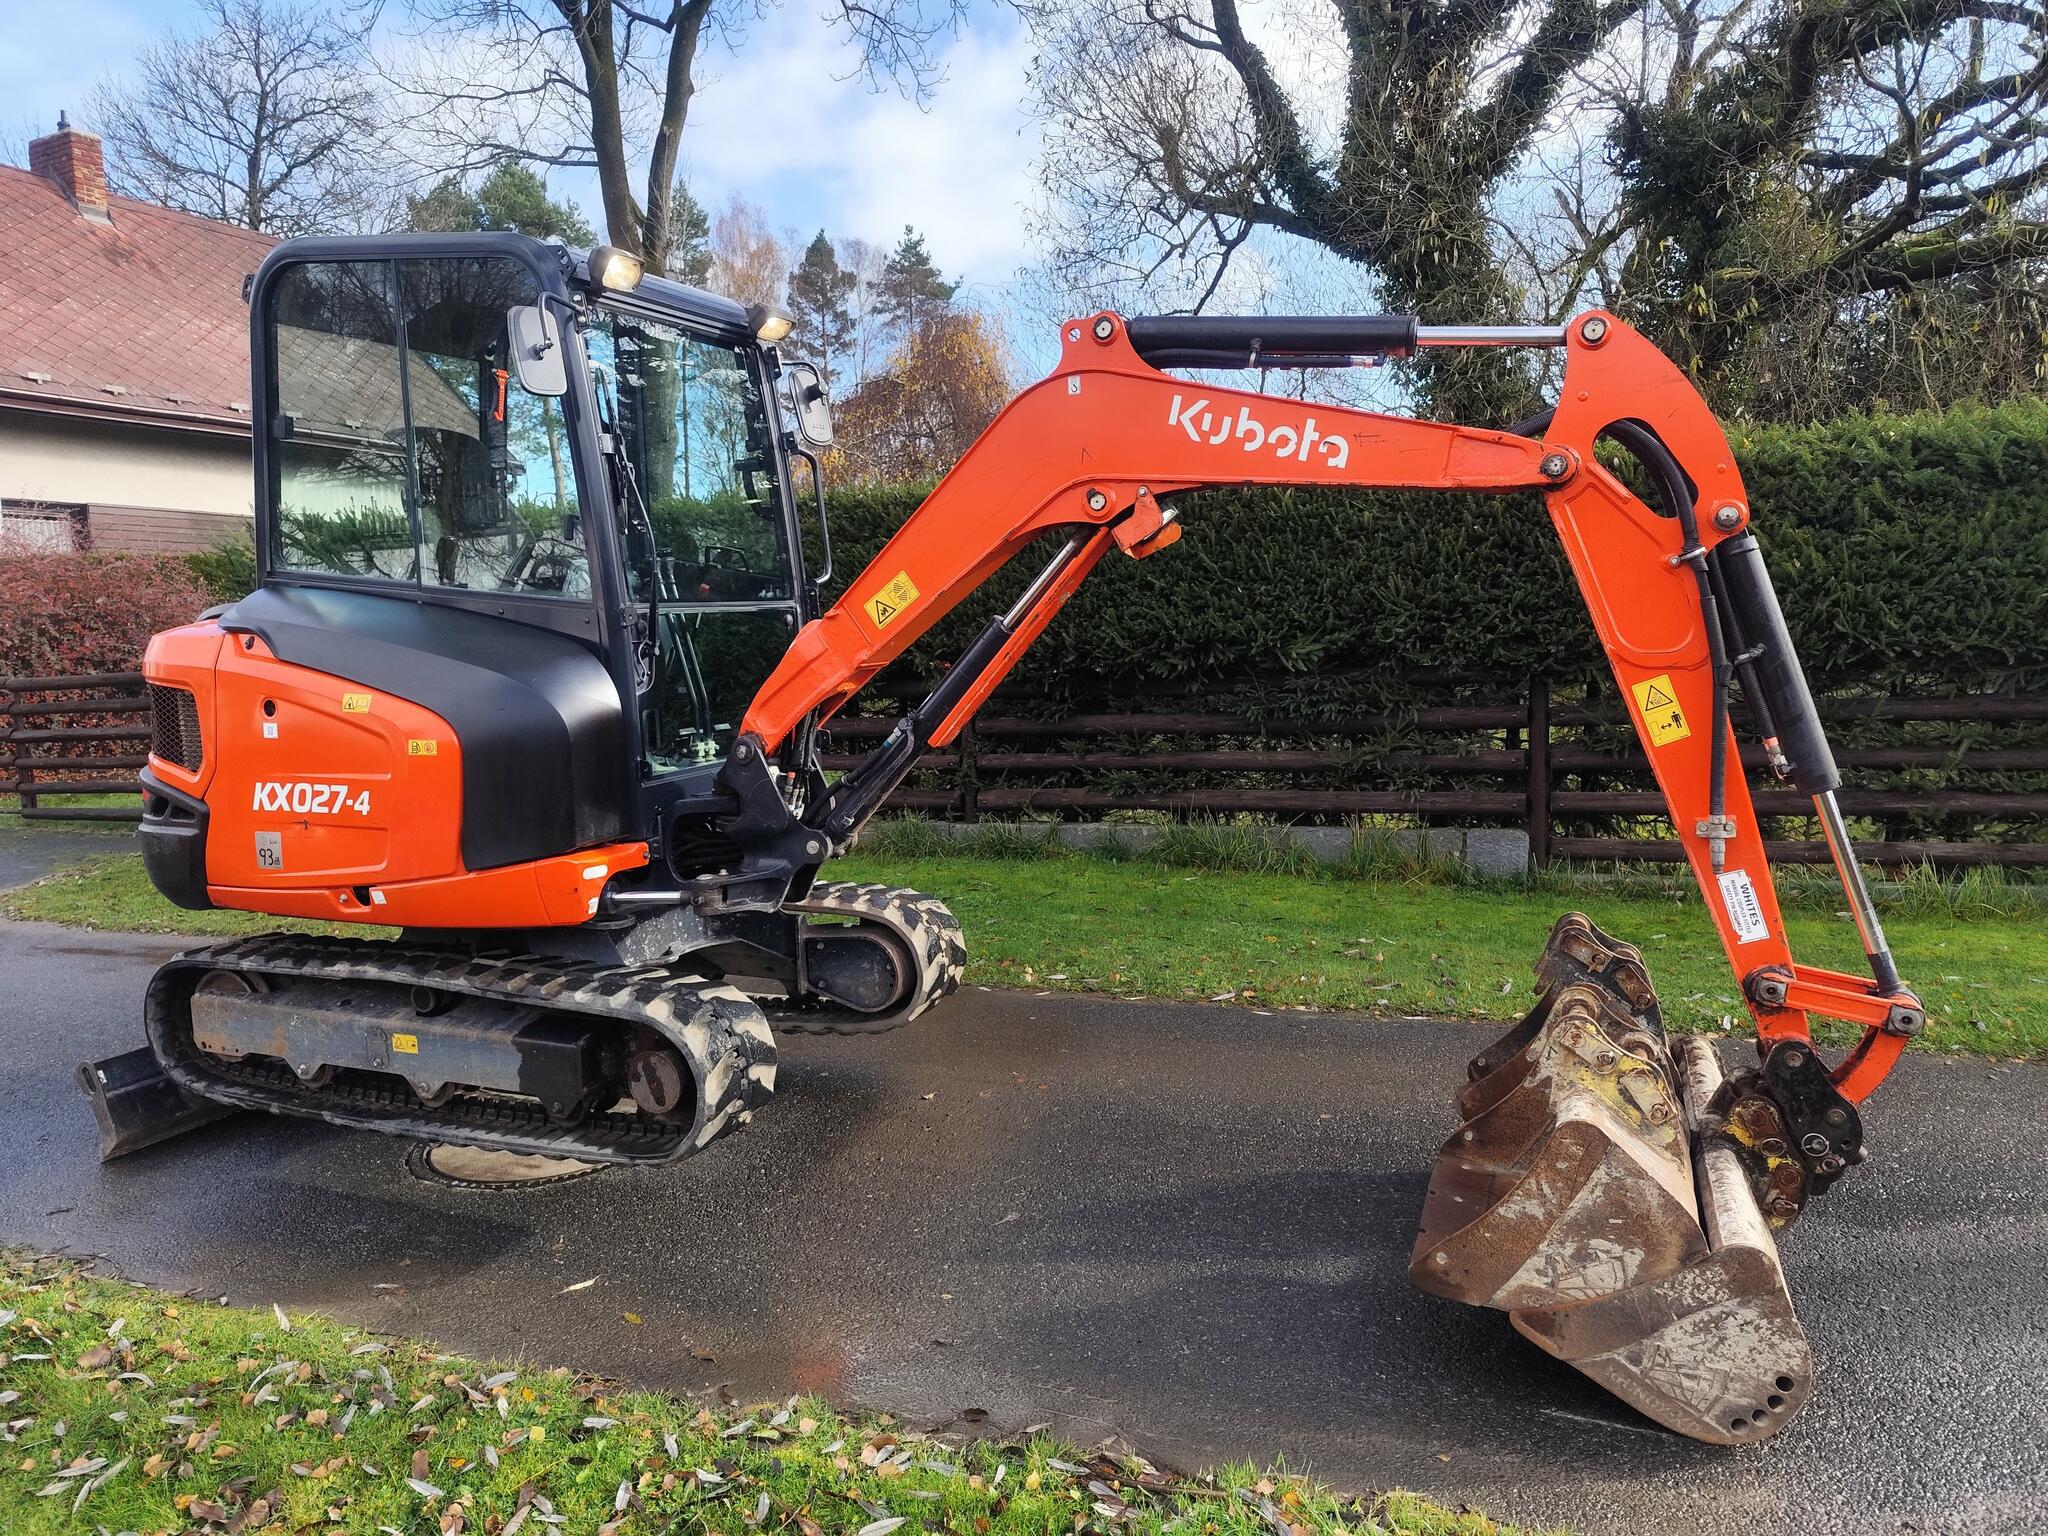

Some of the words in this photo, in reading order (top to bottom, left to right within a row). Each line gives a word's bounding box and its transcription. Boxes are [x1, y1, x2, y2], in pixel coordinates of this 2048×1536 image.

[1168, 394, 1349, 469] Kubota
[252, 782, 371, 816] KX027-4
[1724, 885, 1734, 901] SAFETY
[1740, 883, 1760, 926] WHITES
